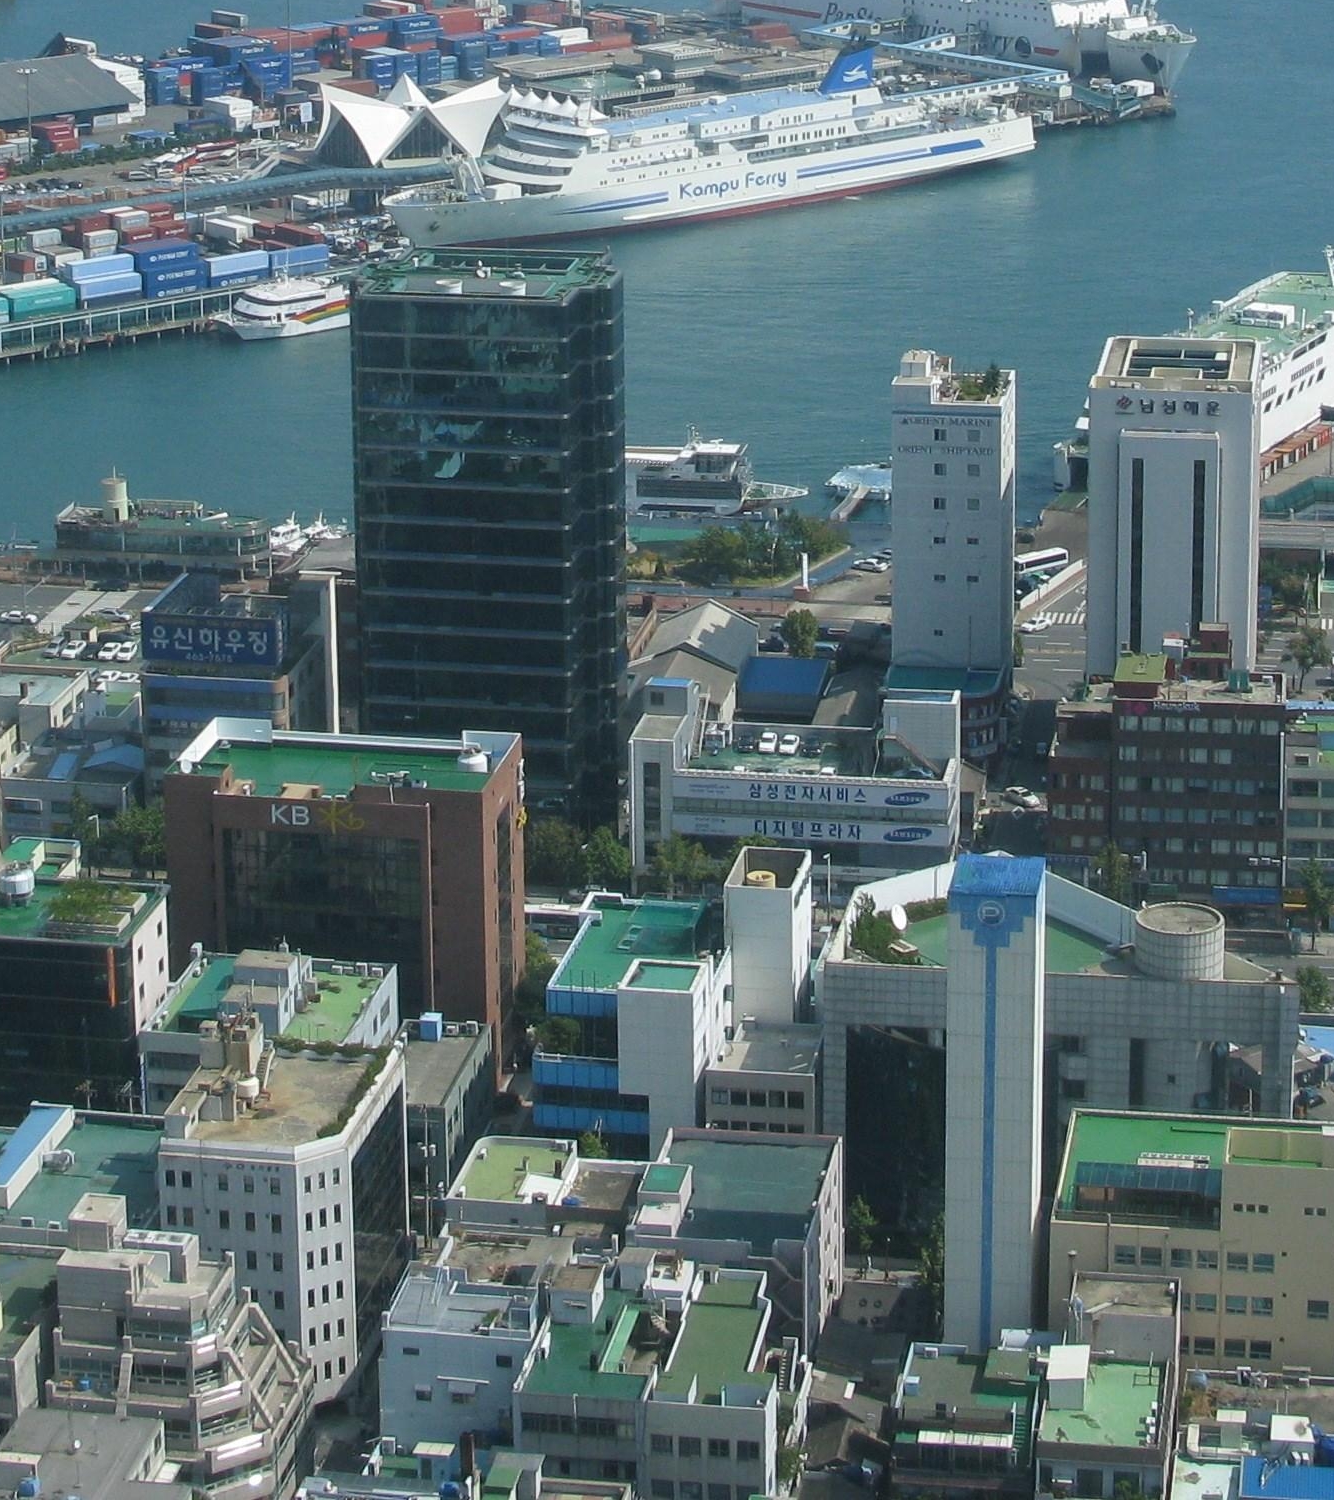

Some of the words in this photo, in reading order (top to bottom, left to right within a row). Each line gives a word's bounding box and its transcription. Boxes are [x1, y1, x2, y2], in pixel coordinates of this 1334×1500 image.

[679, 179, 739, 199] Kampu
[746, 171, 787, 188] Ferry
[1140, 398, 1220, 417] 남성해운
[948, 417, 993, 428] MARINE
[149, 625, 268, 656] 유신하우징
[748, 782, 867, 804] 삼성전자서비스
[271, 803, 310, 826] KB
[754, 818, 862, 840] 디지털프라자
